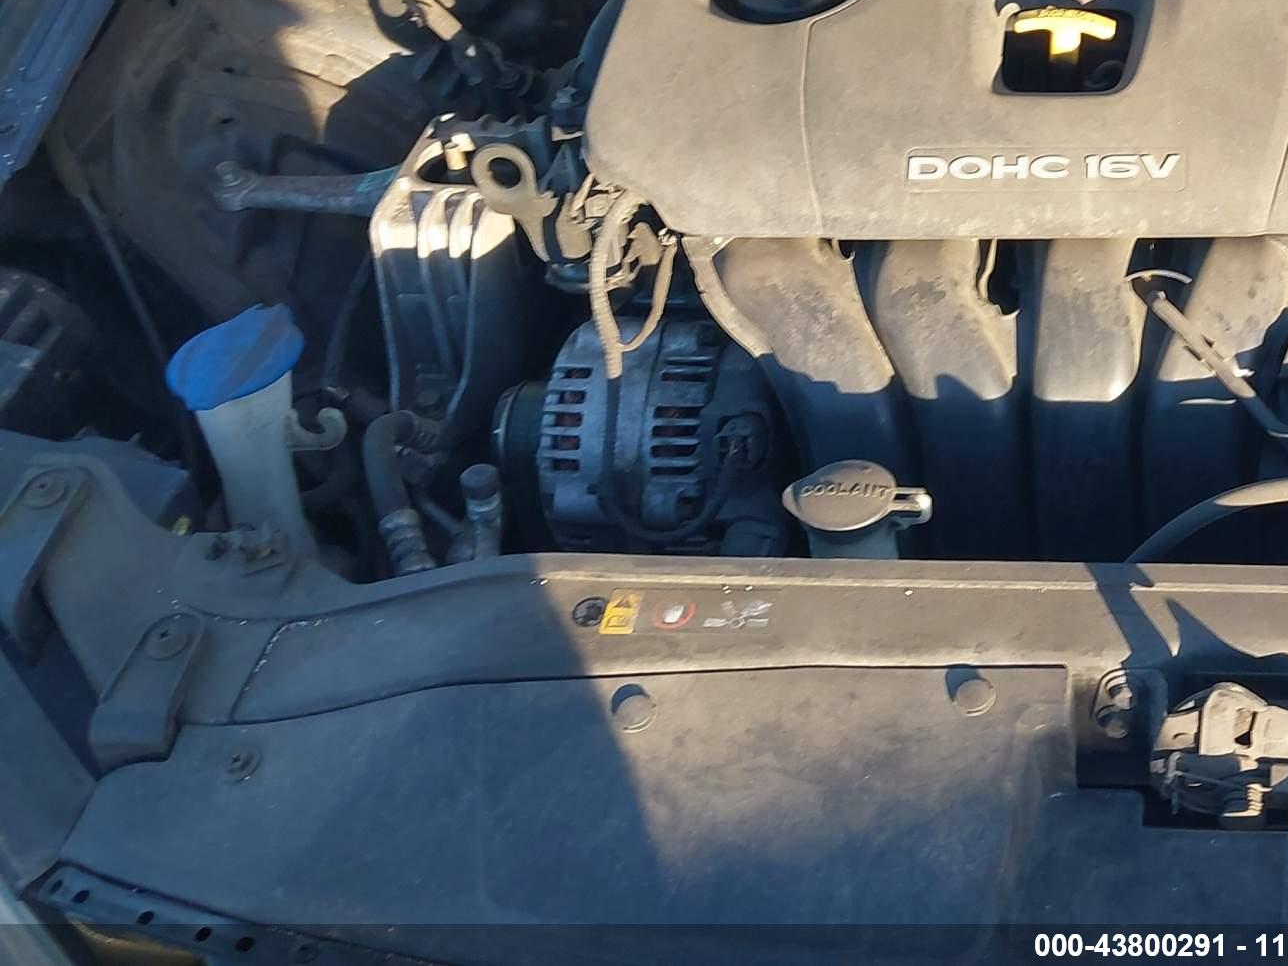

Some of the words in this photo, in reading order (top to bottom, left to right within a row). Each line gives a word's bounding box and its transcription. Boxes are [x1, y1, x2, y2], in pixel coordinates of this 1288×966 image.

[906, 154, 1070, 181] DOHC
[1083, 153, 1181, 181] 16V
[800, 481, 893, 500] COOLANT
